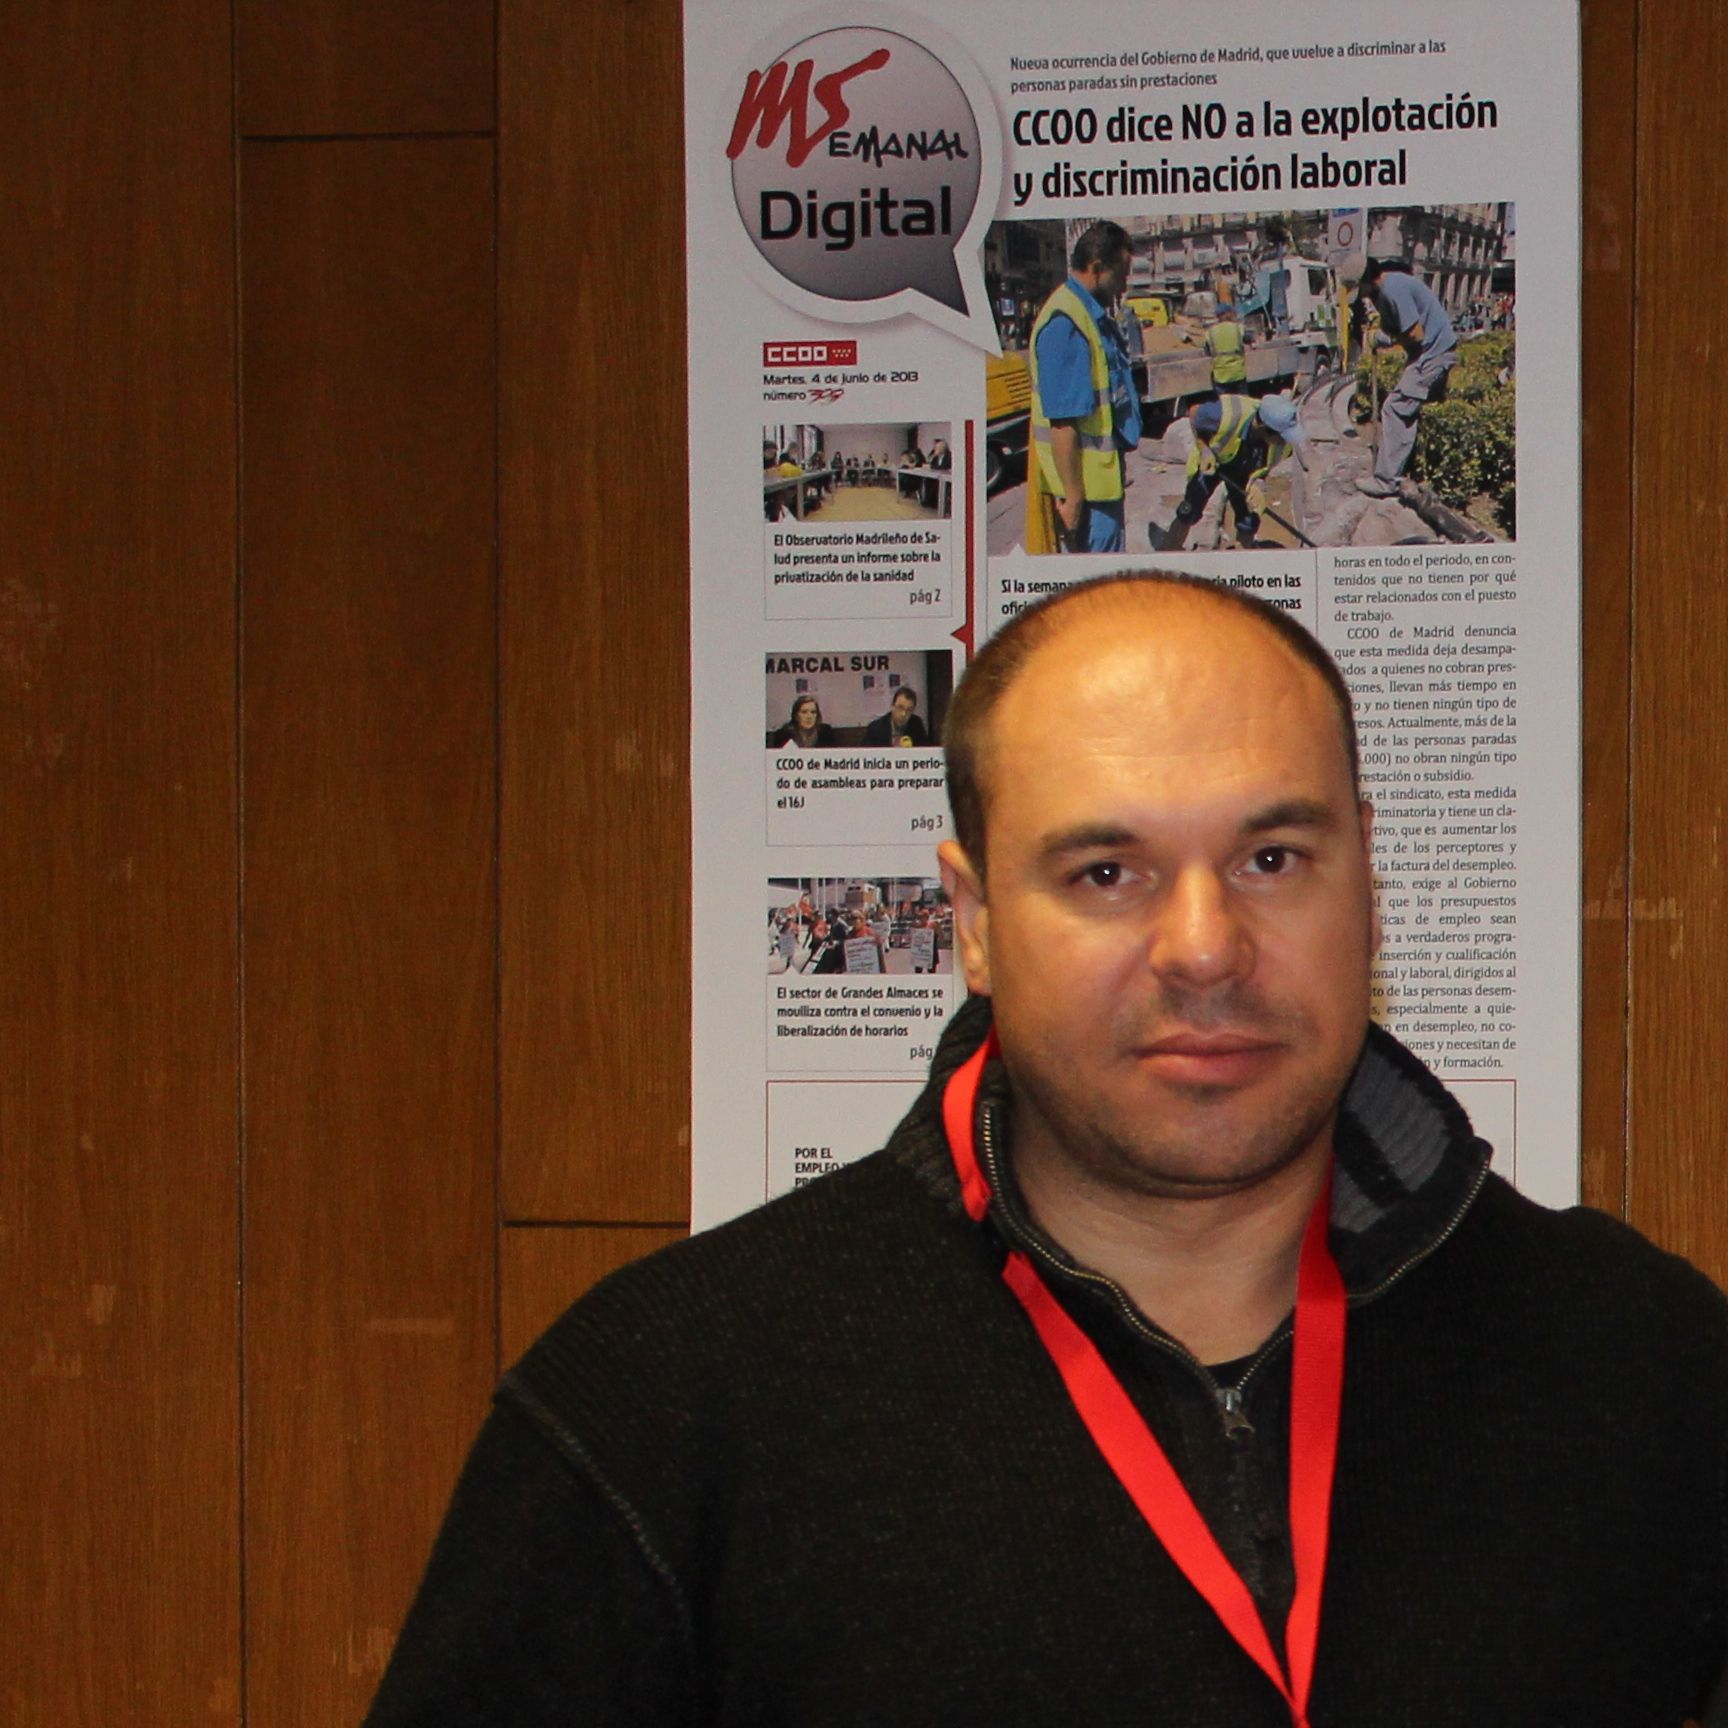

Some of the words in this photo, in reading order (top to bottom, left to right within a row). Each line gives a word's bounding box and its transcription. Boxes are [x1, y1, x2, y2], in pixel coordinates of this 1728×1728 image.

[1052, 53, 1117, 69] ocurrencia
[1119, 51, 1140, 66] del
[1141, 50, 1197, 65] Gobierno
[1200, 49, 1216, 63] de
[1218, 46, 1264, 63] Madrid,
[1266, 48, 1290, 63] que
[1336, 46, 1345, 57] a
[1347, 40, 1416, 57] discriminar
[1418, 43, 1426, 54] a
[1428, 39, 1447, 54] las
[1010, 80, 1067, 95] personas
[1069, 76, 1118, 93] paradas
[1119, 75, 1138, 88] sin
[1140, 72, 1218, 91] prestaciones
[1013, 107, 1098, 147] CCOO
[1106, 106, 1174, 143] dice
[1181, 103, 1228, 141] NO
[1235, 111, 1255, 138] a
[1264, 100, 1293, 137] la
[1301, 91, 1498, 142] explotación
[1013, 172, 1034, 207] y
[1042, 152, 1282, 199] discriminación
[1291, 148, 1407, 189] laboral
[760, 185, 952, 252] Digital
[767, 345, 828, 362] CCOO
[811, 374, 821, 384] 4
[824, 374, 839, 385] de
[841, 372, 870, 386] junio
[873, 372, 887, 383] de
[890, 371, 919, 383] 2013
[763, 389, 807, 401] número
[774, 535, 784, 547] El
[855, 532, 908, 545] Madrileño
[910, 532, 924, 544] de
[925, 531, 941, 544] Sa-
[774, 552, 791, 565] lud
[793, 553, 840, 566] presenta
[841, 554, 855, 564] un
[857, 551, 899, 564] informe
[900, 551, 929, 563] sobre
[931, 550, 941, 562] la
[1334, 556, 1366, 568] horas
[1368, 558, 1382, 567] en
[1385, 555, 1411, 567] todo
[1413, 554, 1423, 567] el
[1425, 554, 1473, 569] periodo,
[1475, 555, 1489, 565] en
[1491, 554, 1516, 564] con-
[845, 570, 860, 582] de
[861, 570, 871, 582] la
[873, 569, 915, 582] sanidad
[910, 589, 933, 605] pág
[934, 588, 941, 602] 2
[851, 655, 890, 671] SUR
[776, 758, 804, 771] CCOO
[807, 758, 821, 770] de
[823, 757, 860, 770] Madrid
[863, 757, 892, 770] inicia
[895, 759, 910, 770] un
[912, 758, 944, 772] perio-
[776, 777, 791, 789] do
[794, 777, 808, 789] de
[811, 776, 867, 789] asambleas
[870, 778, 895, 790] para
[898, 777, 944, 791] preparar
[777, 796, 787, 809] el
[788, 796, 805, 809] 16J
[911, 815, 934, 831] pág
[936, 814, 944, 829] 3
